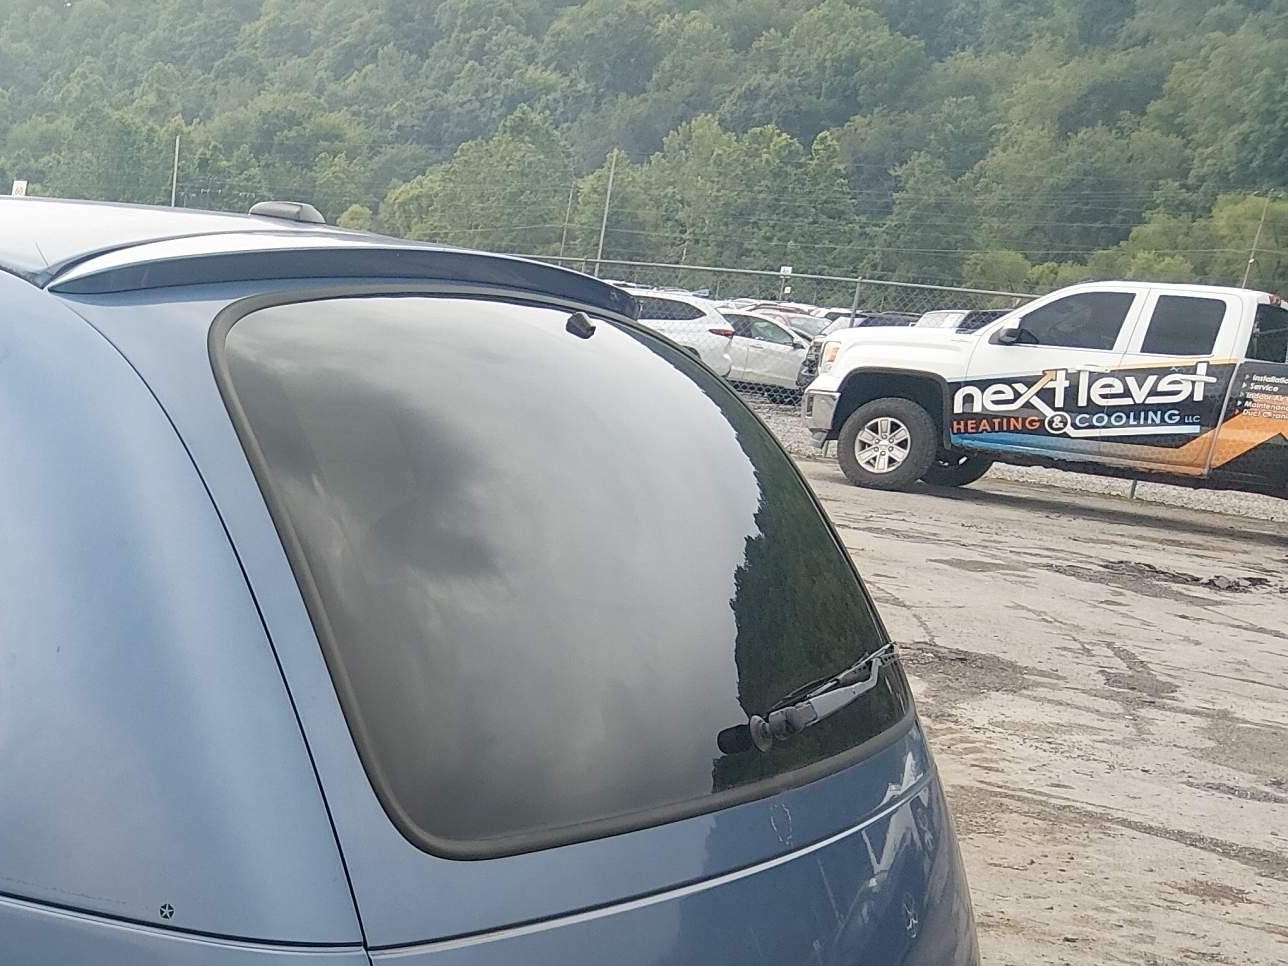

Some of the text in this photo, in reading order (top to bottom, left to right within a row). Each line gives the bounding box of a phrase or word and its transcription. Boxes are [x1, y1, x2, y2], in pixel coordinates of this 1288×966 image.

[953, 369, 1070, 414] next
[1250, 382, 1279, 392] Service
[953, 416, 1041, 433] HEATING
[1075, 409, 1181, 427] COOLING
[1184, 415, 1201, 423] LLC
